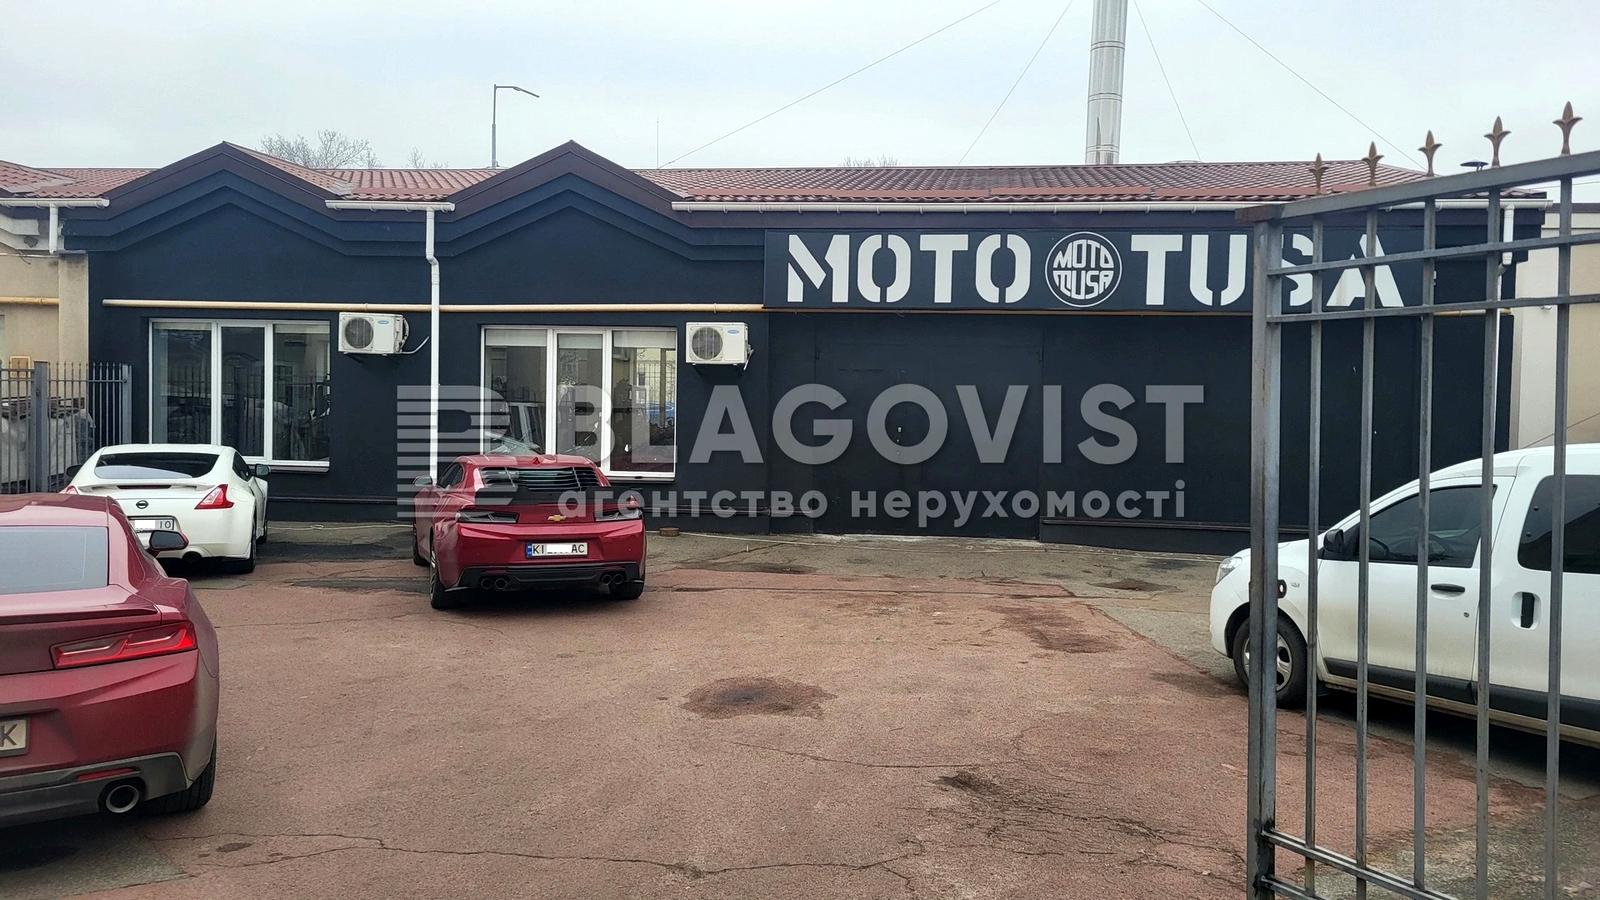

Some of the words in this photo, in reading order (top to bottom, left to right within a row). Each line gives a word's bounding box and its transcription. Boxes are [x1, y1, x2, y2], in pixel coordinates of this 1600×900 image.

[787, 234, 1031, 303] MOTO
[1130, 234, 1405, 307] TUSA
[1053, 239, 1114, 268] MOTO
